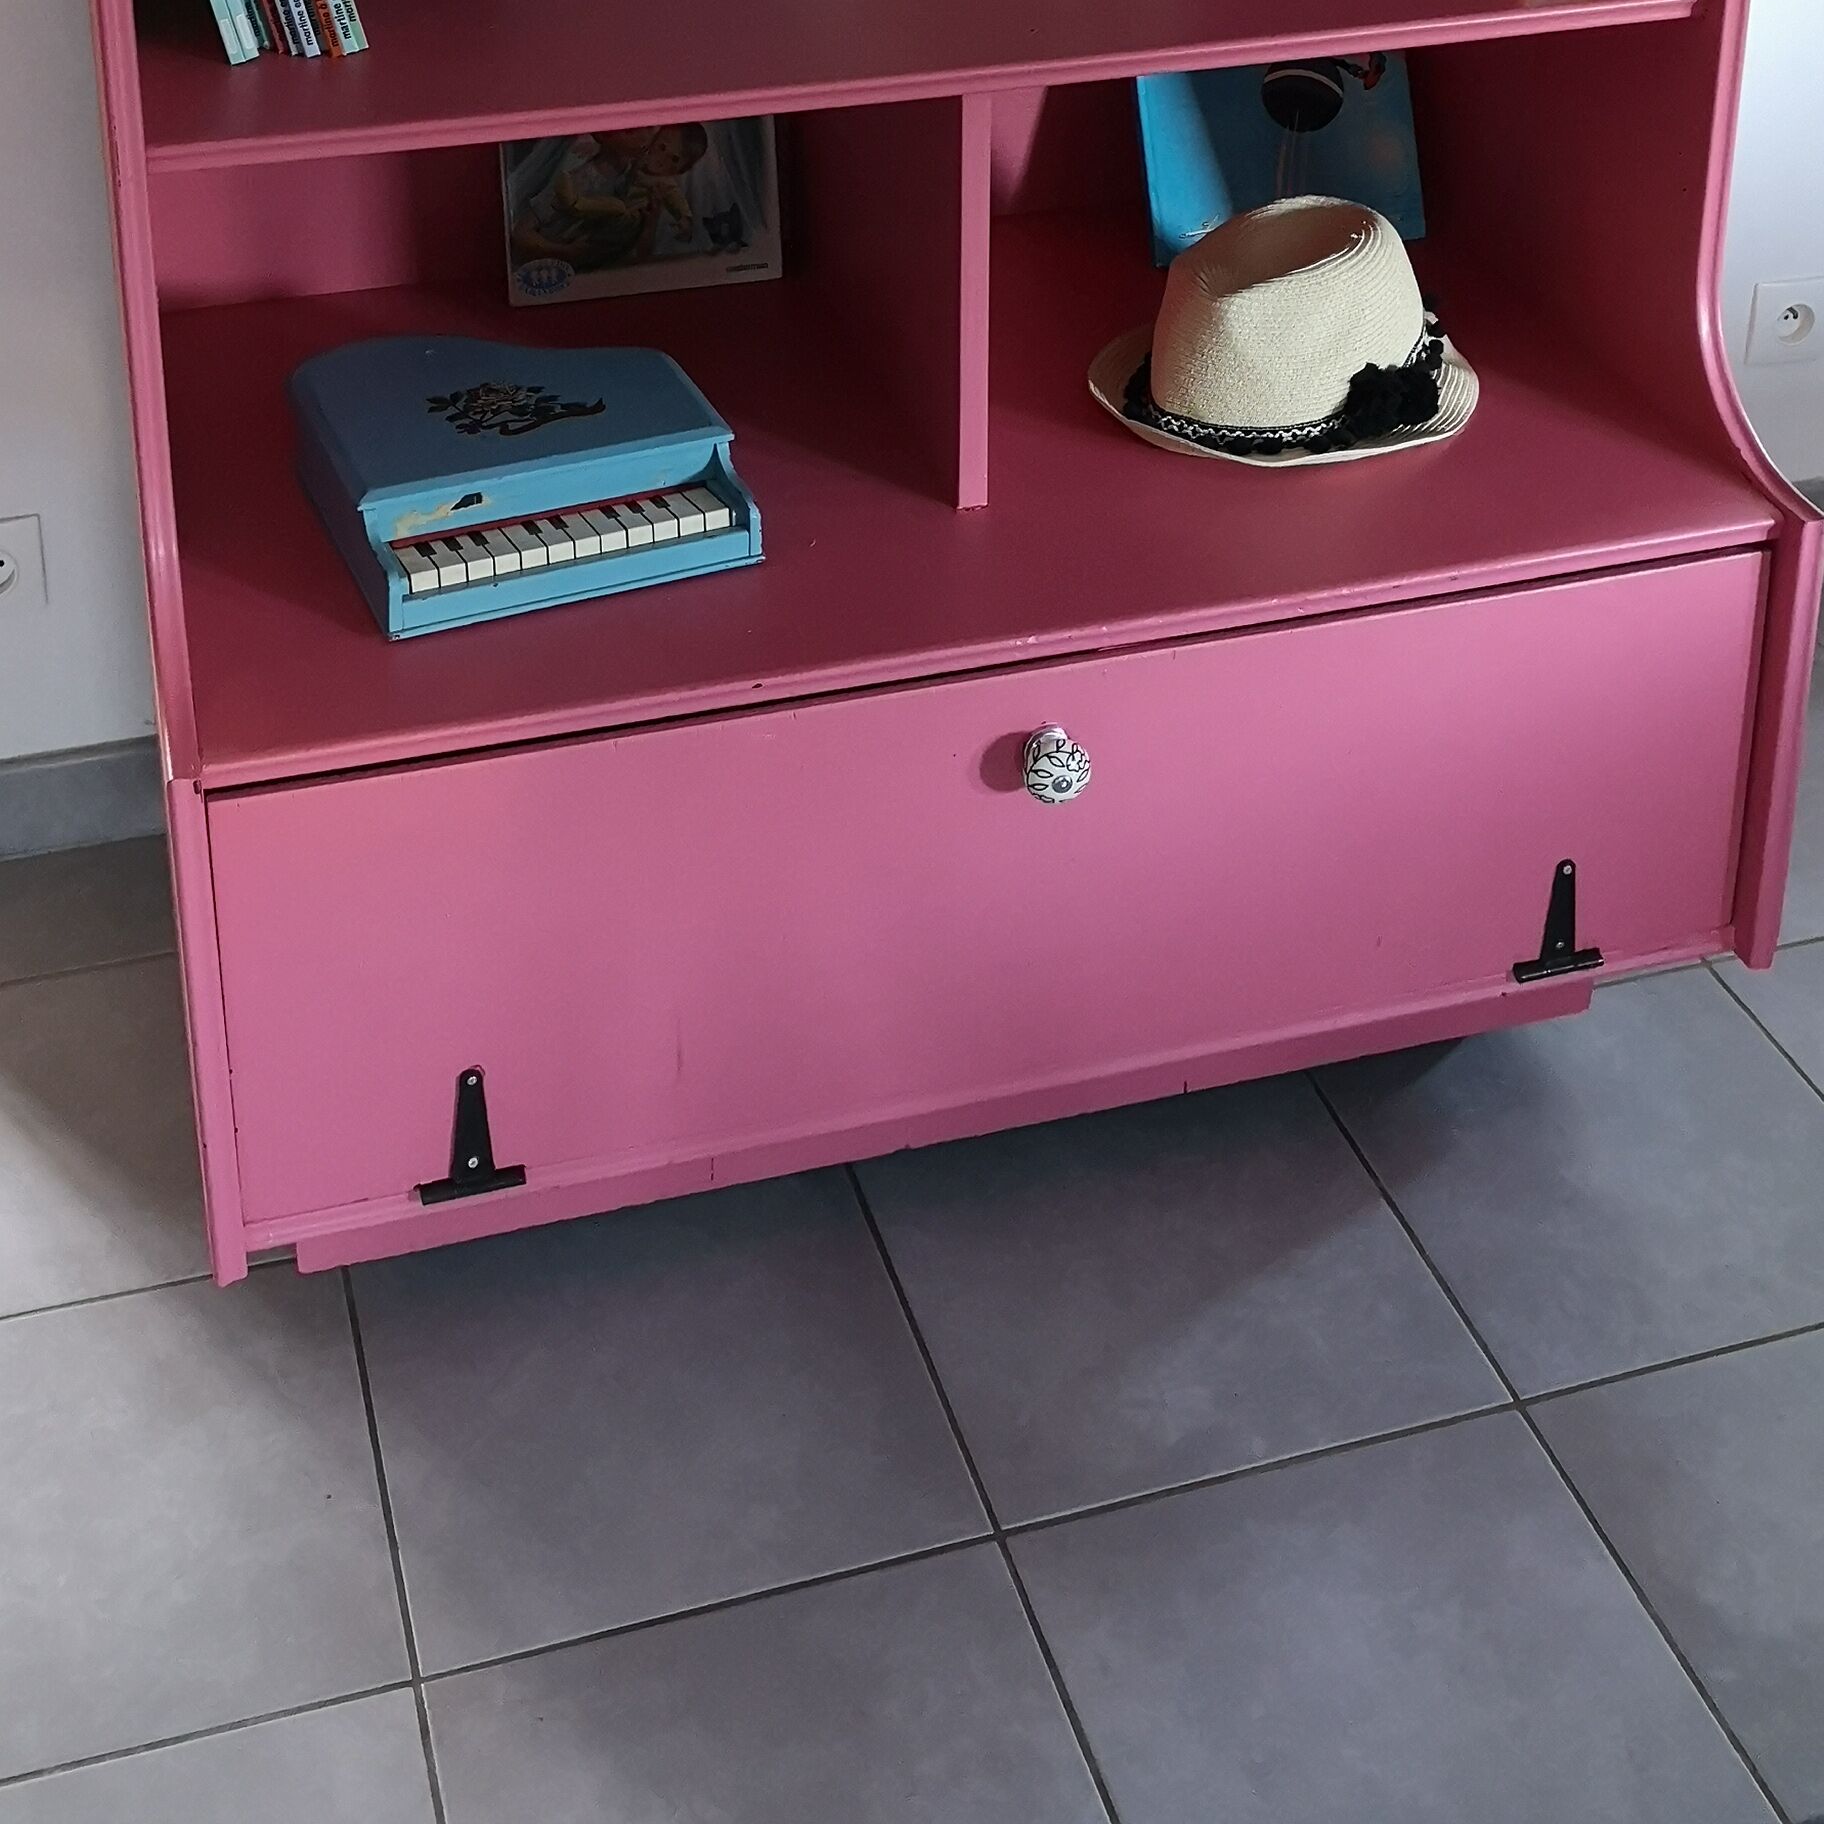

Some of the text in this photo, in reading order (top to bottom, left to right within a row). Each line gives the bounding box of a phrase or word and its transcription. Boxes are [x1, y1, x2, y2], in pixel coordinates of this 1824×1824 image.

[283, 9, 300, 45] martine
[297, 10, 314, 46] martine
[322, 12, 340, 48] martine
[333, 3, 352, 40] martine
